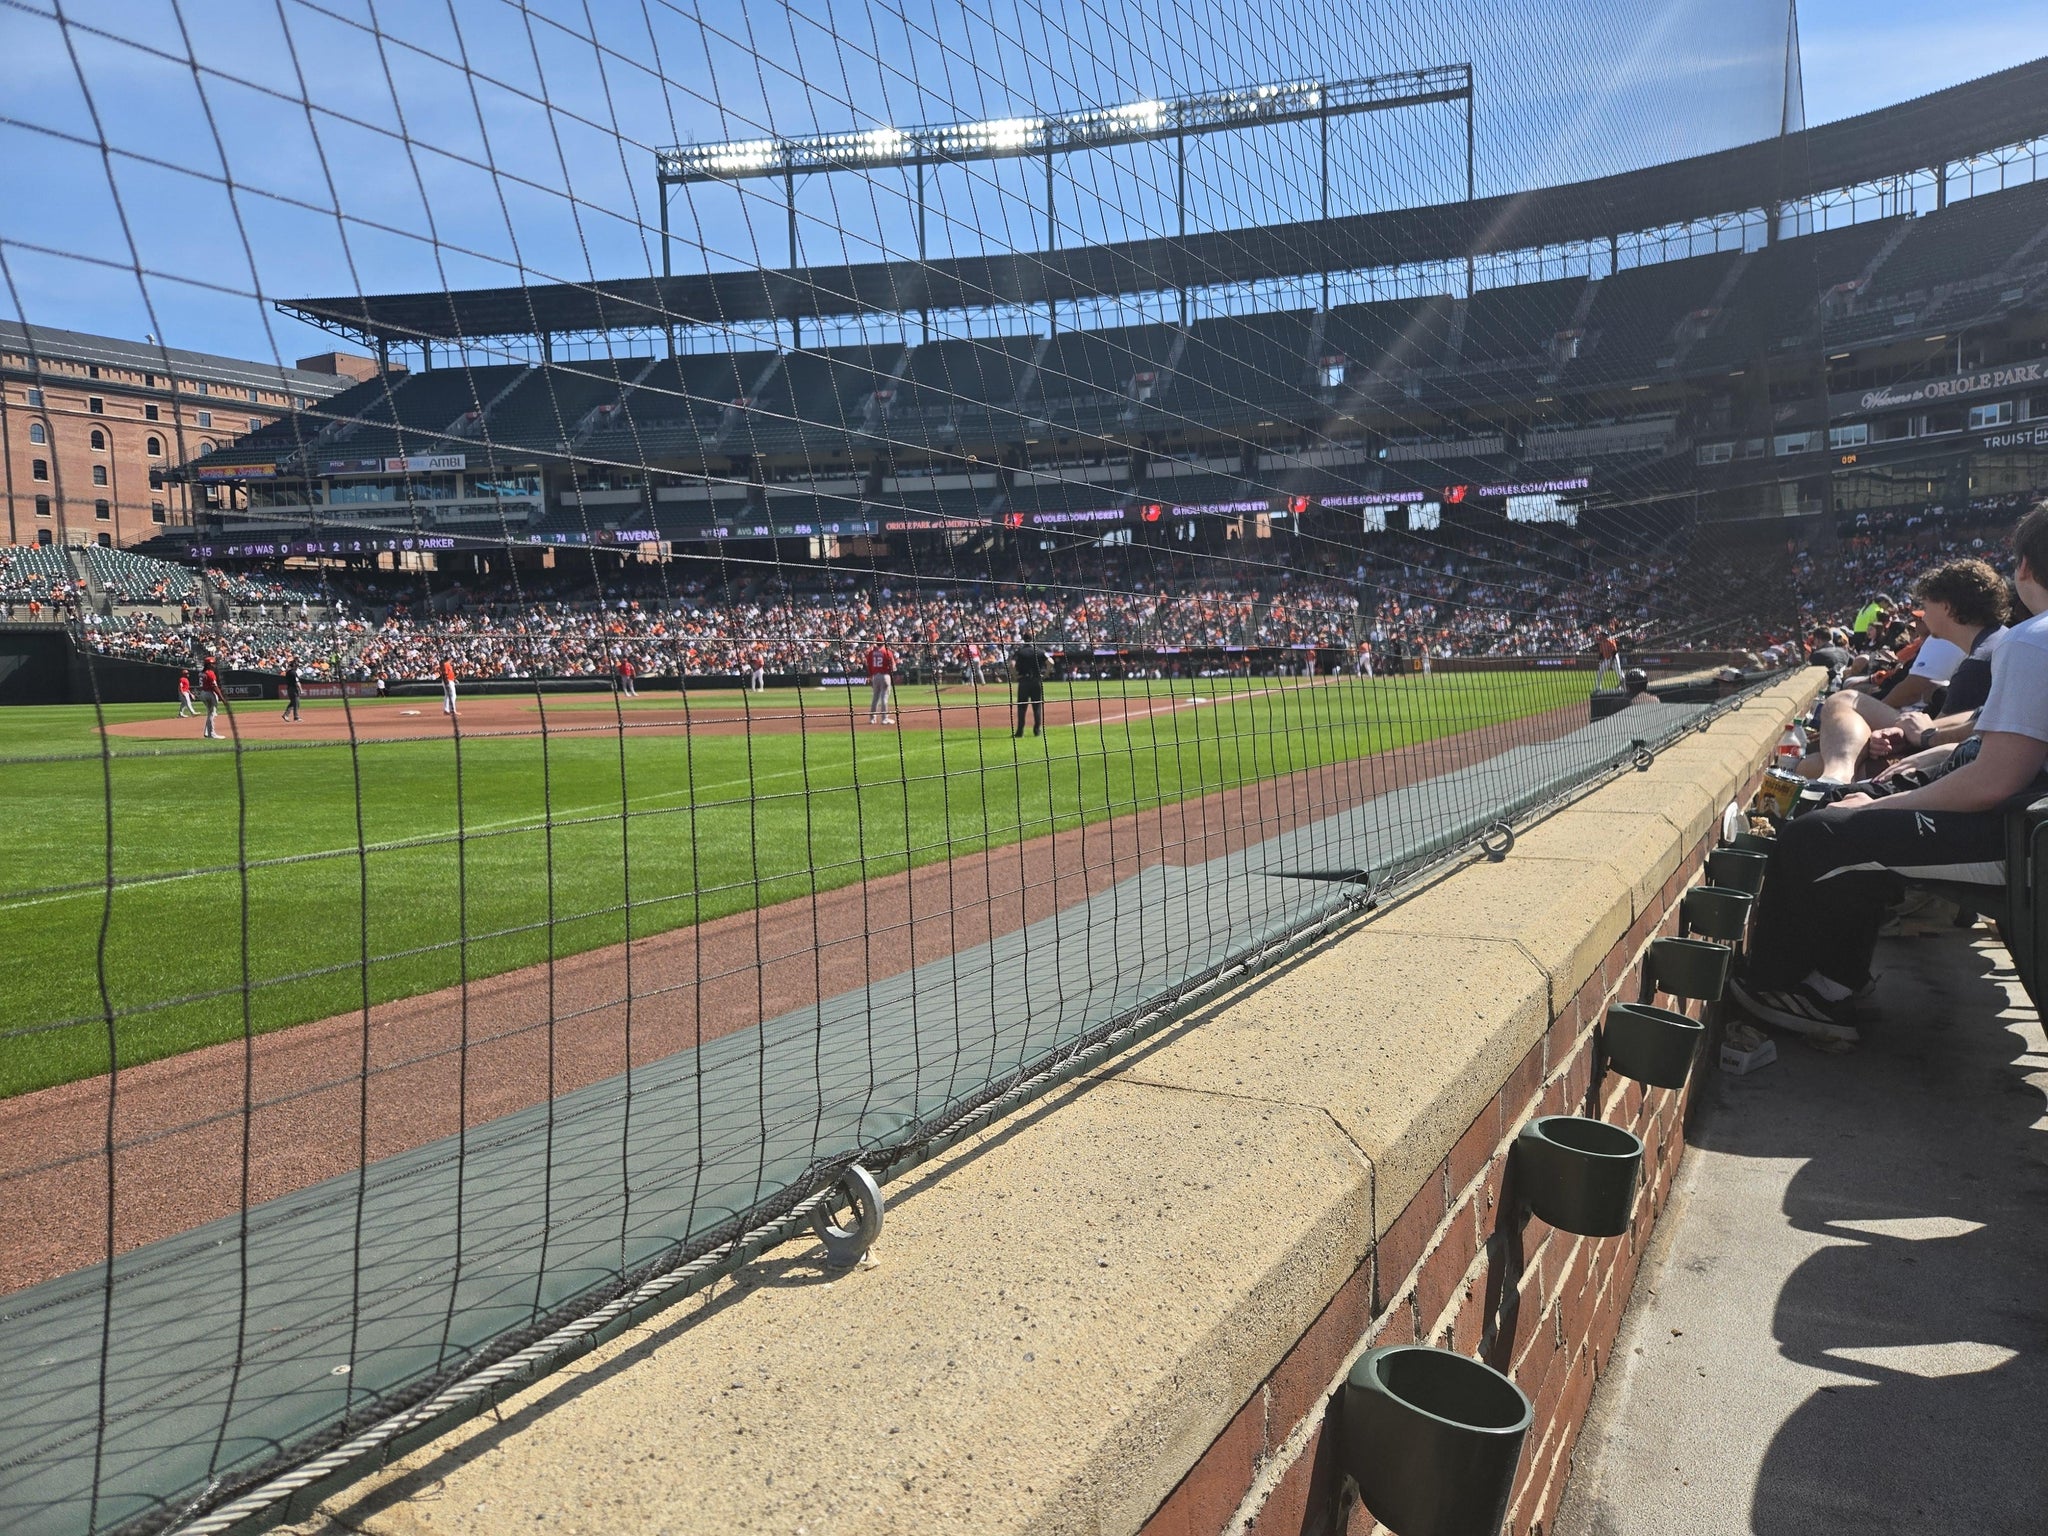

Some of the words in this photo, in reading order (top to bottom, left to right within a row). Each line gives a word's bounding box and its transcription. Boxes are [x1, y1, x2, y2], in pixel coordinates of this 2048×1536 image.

[1861, 386, 1912, 409] Welcome
[1912, 390, 1924, 400] to
[1924, 372, 1991, 399] ORIOLE
[1993, 363, 2041, 388] PARK
[1983, 431, 2033, 449] TRUIST
[912, 520, 931, 530] PARK
[615, 530, 660, 541] TAVERAS
[752, 525, 769, 536] .194
[779, 526, 793, 534] OPS
[832, 523, 840, 533] 0
[419, 538, 454, 549] PARKER
[556, 533, 566, 543] 74
[254, 544, 274, 555] WAS
[281, 544, 288, 554] 0
[307, 542, 326, 553] BAL
[333, 541, 340, 552] 2
[353, 541, 361, 552] 2
[372, 540, 377, 550] 1
[388, 540, 396, 550] 2
[873, 657, 883, 667] 12
